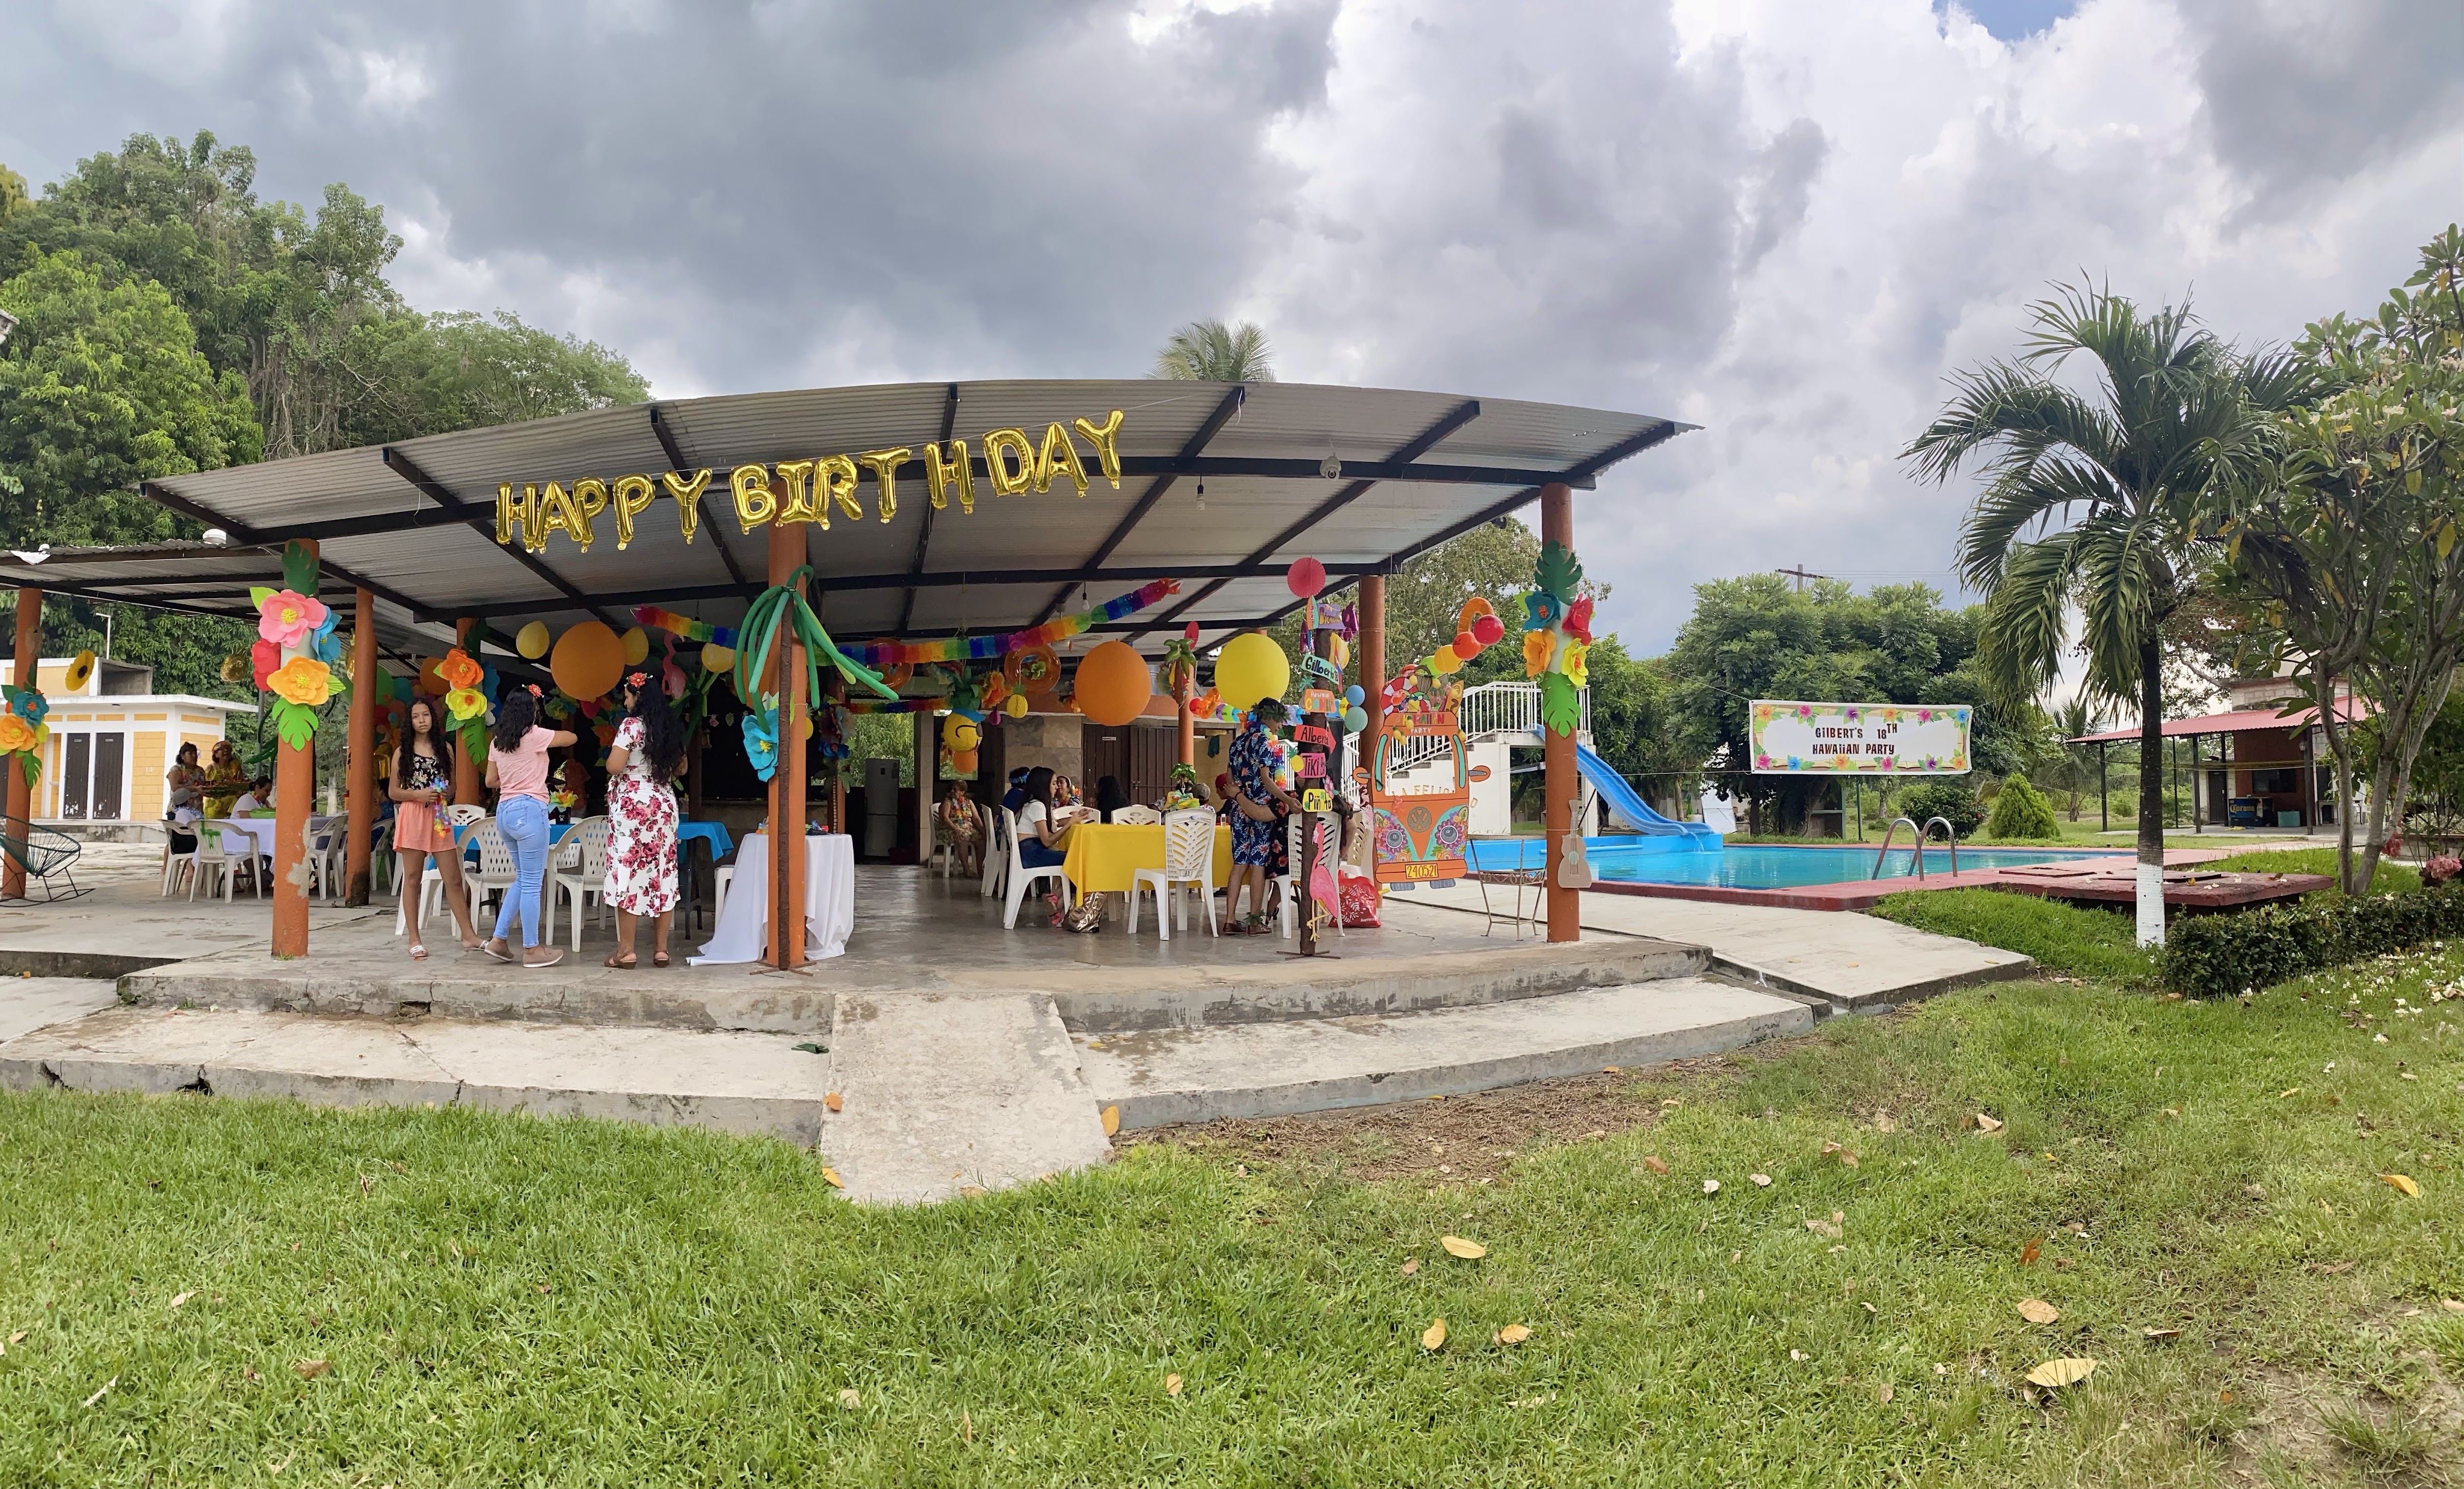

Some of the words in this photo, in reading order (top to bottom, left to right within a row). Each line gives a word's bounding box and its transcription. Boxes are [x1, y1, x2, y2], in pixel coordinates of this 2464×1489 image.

[496, 468, 713, 554] HAPPY
[1865, 744, 1895, 755] PARTY
[2229, 804, 2255, 813] Corona
